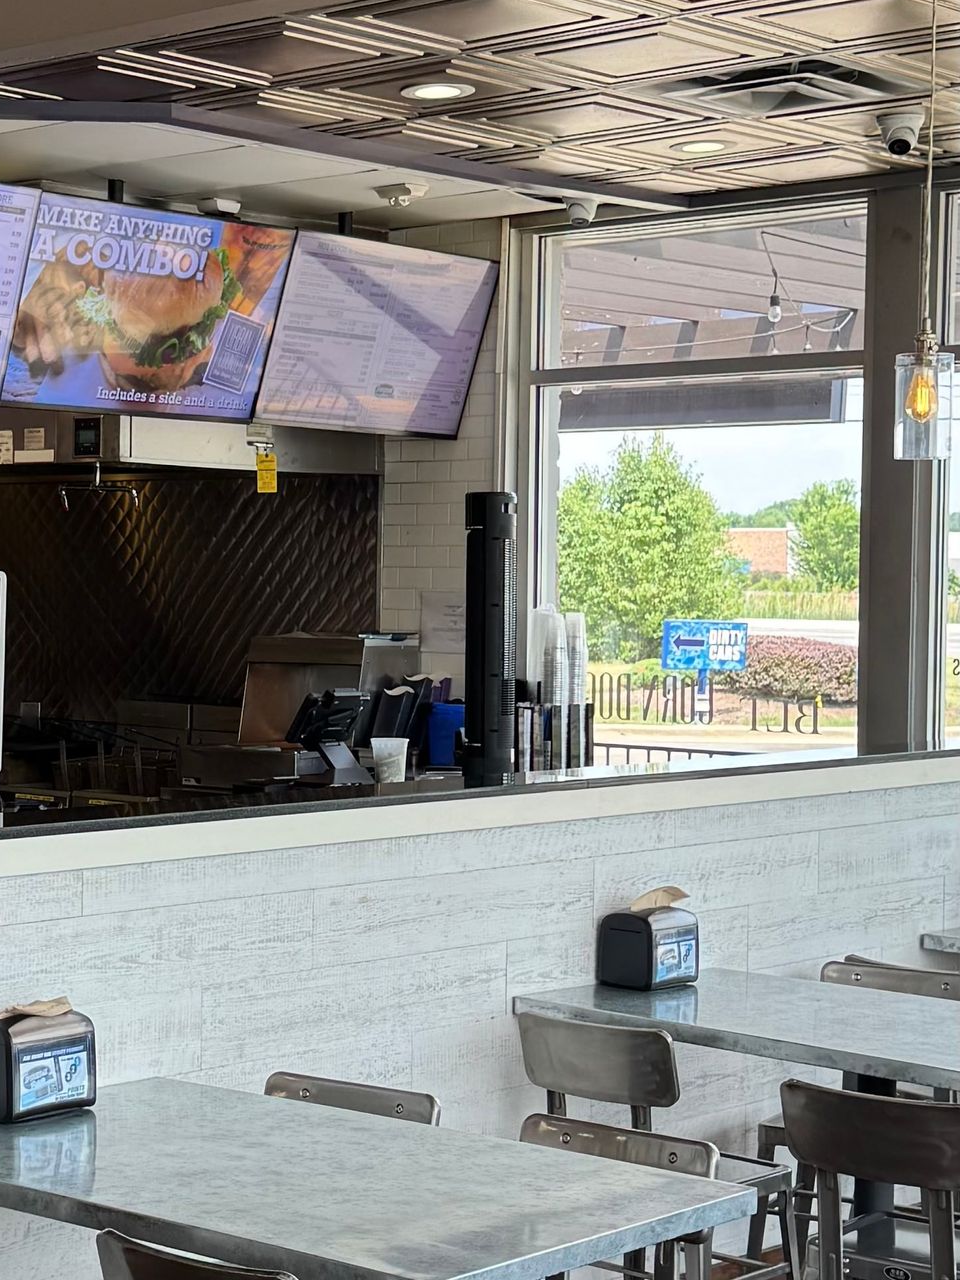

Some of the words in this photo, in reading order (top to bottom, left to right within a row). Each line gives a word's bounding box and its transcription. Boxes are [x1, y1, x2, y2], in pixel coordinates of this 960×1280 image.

[36, 204, 104, 232] MAKE
[104, 214, 212, 248] ANYTHING
[29, 227, 57, 262] A
[66, 233, 209, 282] COMBO!
[96, 386, 147, 403] Includes
[148, 393, 156, 403] a
[158, 391, 183, 405] side
[184, 396, 206, 408] and
[207, 399, 215, 408] a
[217, 397, 248, 412] drink
[708, 628, 745, 645] DIRTY
